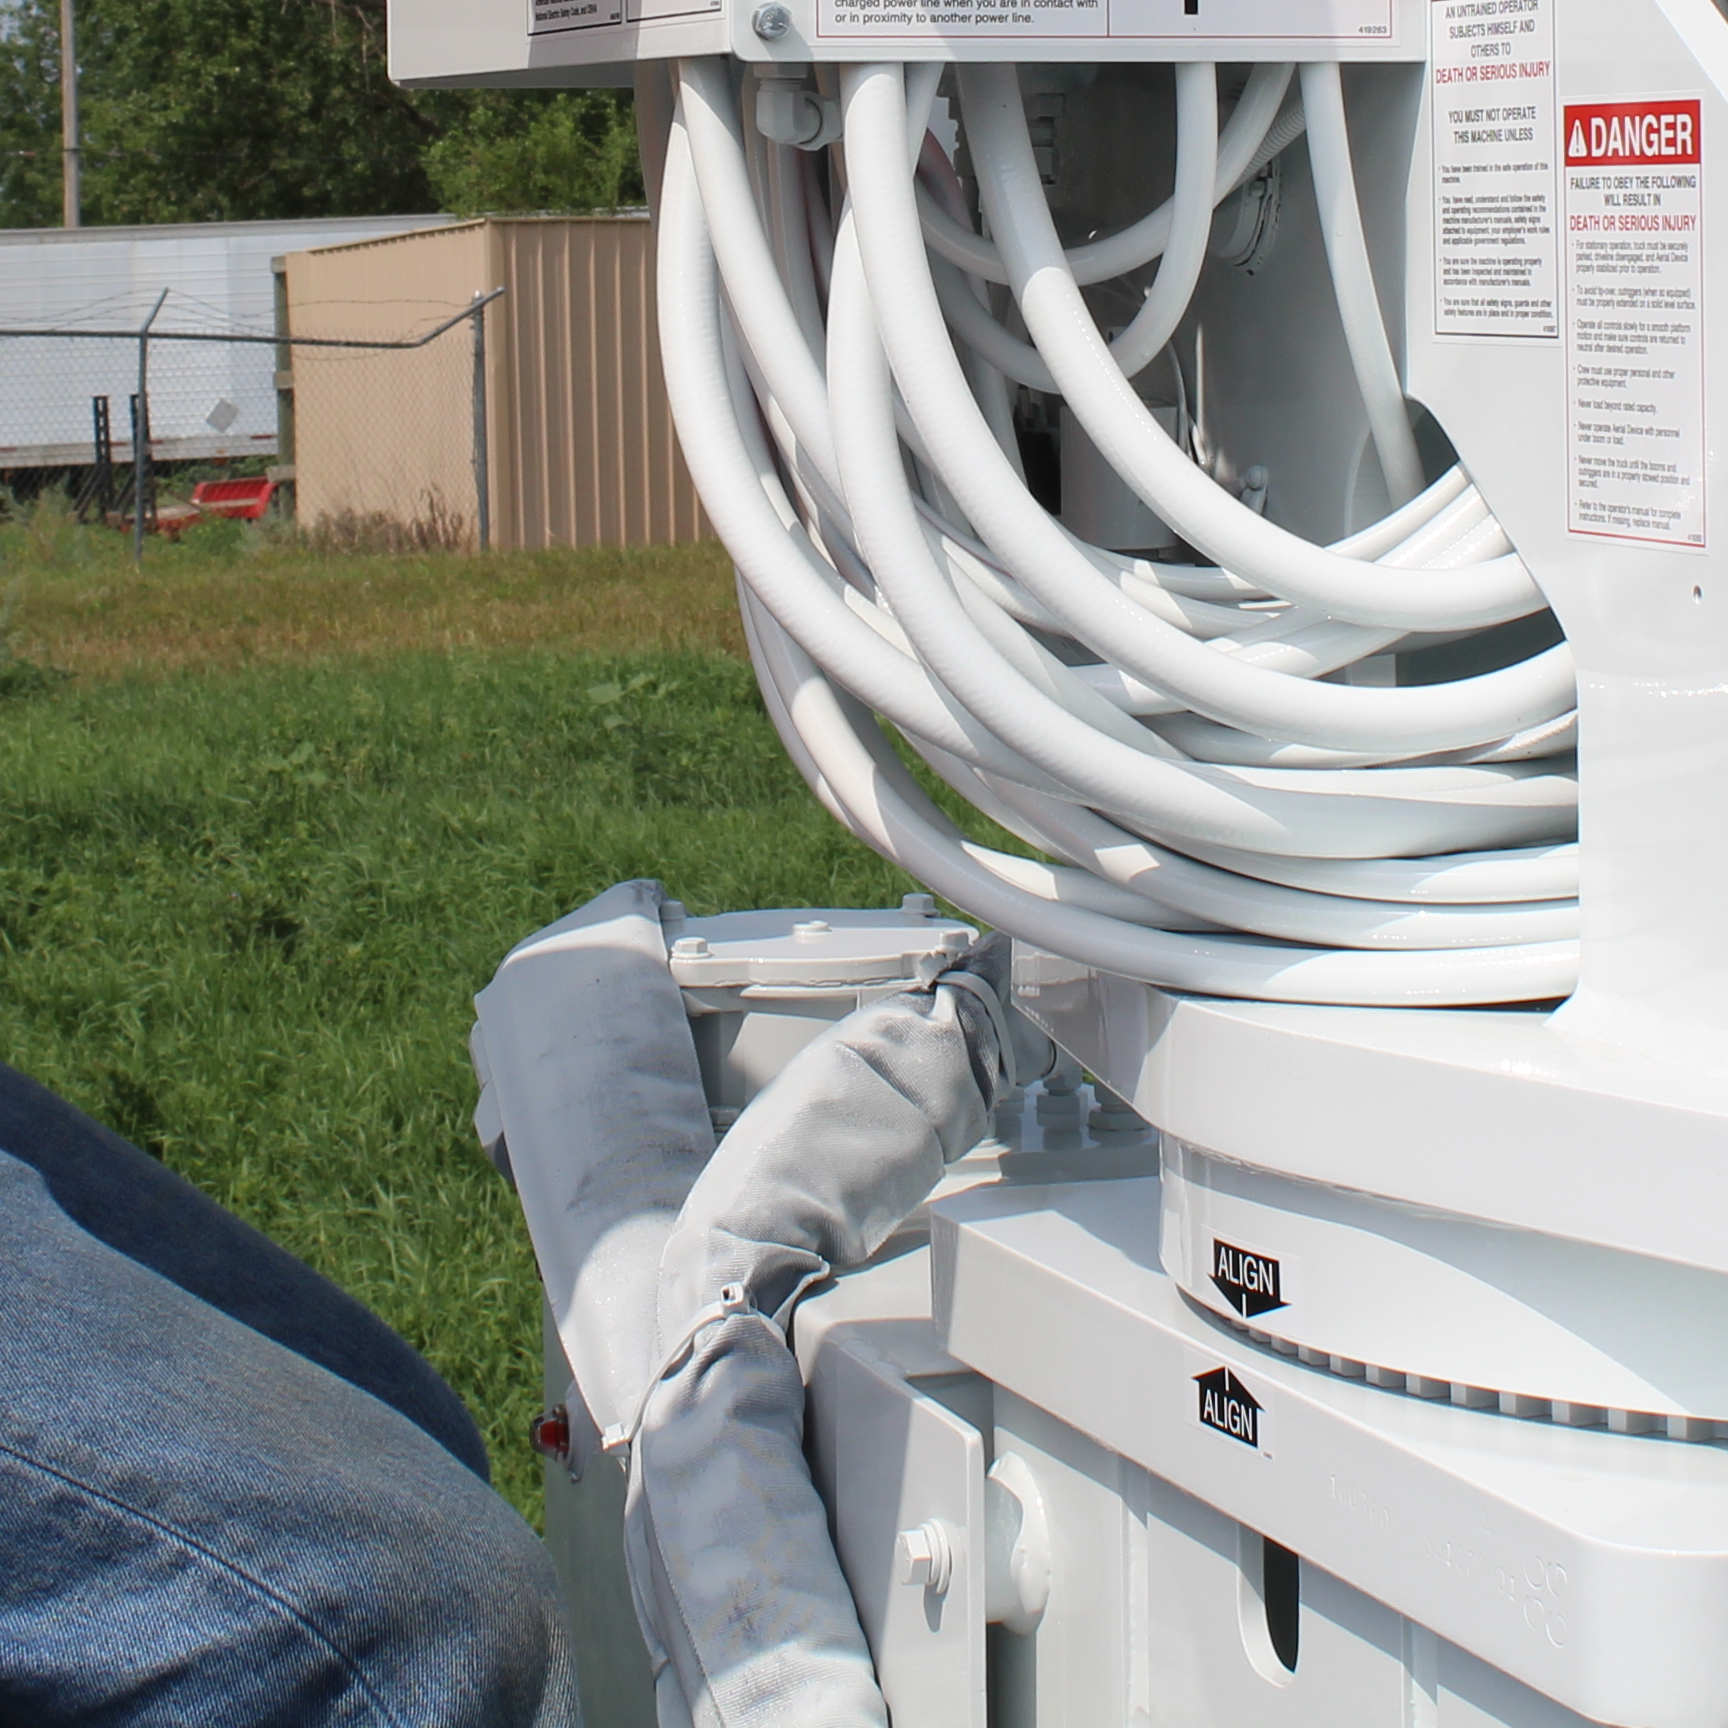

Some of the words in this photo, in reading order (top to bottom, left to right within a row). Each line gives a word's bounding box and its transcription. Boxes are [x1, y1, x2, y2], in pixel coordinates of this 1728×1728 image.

[1445, 6, 1455, 18] AN
[1456, 1, 1497, 18] UNTRAINED
[1449, 23, 1485, 39] SUBJECTS
[1487, 20, 1517, 35] HIMSELF
[1519, 19, 1534, 33] AND
[1470, 42, 1499, 58] OTHERS
[1500, 42, 1511, 55] TO
[1435, 67, 1463, 84] DEATH
[1464, 66, 1477, 82] OR
[1479, 63, 1517, 81] SERIOUS
[1518, 60, 1550, 77] INJURY
[1448, 110, 1463, 124] YOU
[1464, 108, 1484, 123] MUST
[1485, 107, 1500, 121] NOT
[1501, 105, 1536, 121] OPERATE
[1453, 130, 1469, 143] THIS
[1470, 128, 1502, 143] MACHINE
[1505, 126, 1533, 142] UNLESS
[1590, 114, 1693, 158] DANGER
[1570, 176, 1600, 190] FAILURE
[1601, 176, 1611, 189] TO
[1612, 176, 1633, 189] OBEY
[1634, 175, 1650, 189] THE
[1651, 174, 1696, 189] FOLLOWING
[1603, 193, 1621, 206] WILL
[1622, 193, 1651, 206] RESULT
[1652, 193, 1661, 206] IN
[1569, 214, 1600, 231] DEATH
[1602, 214, 1616, 231] OR
[1617, 214, 1659, 231] SERIOUS
[1661, 214, 1696, 231] INJURY
[1218, 1246, 1274, 1296] ALIGN
[1203, 1389, 1253, 1441] ALIGN
